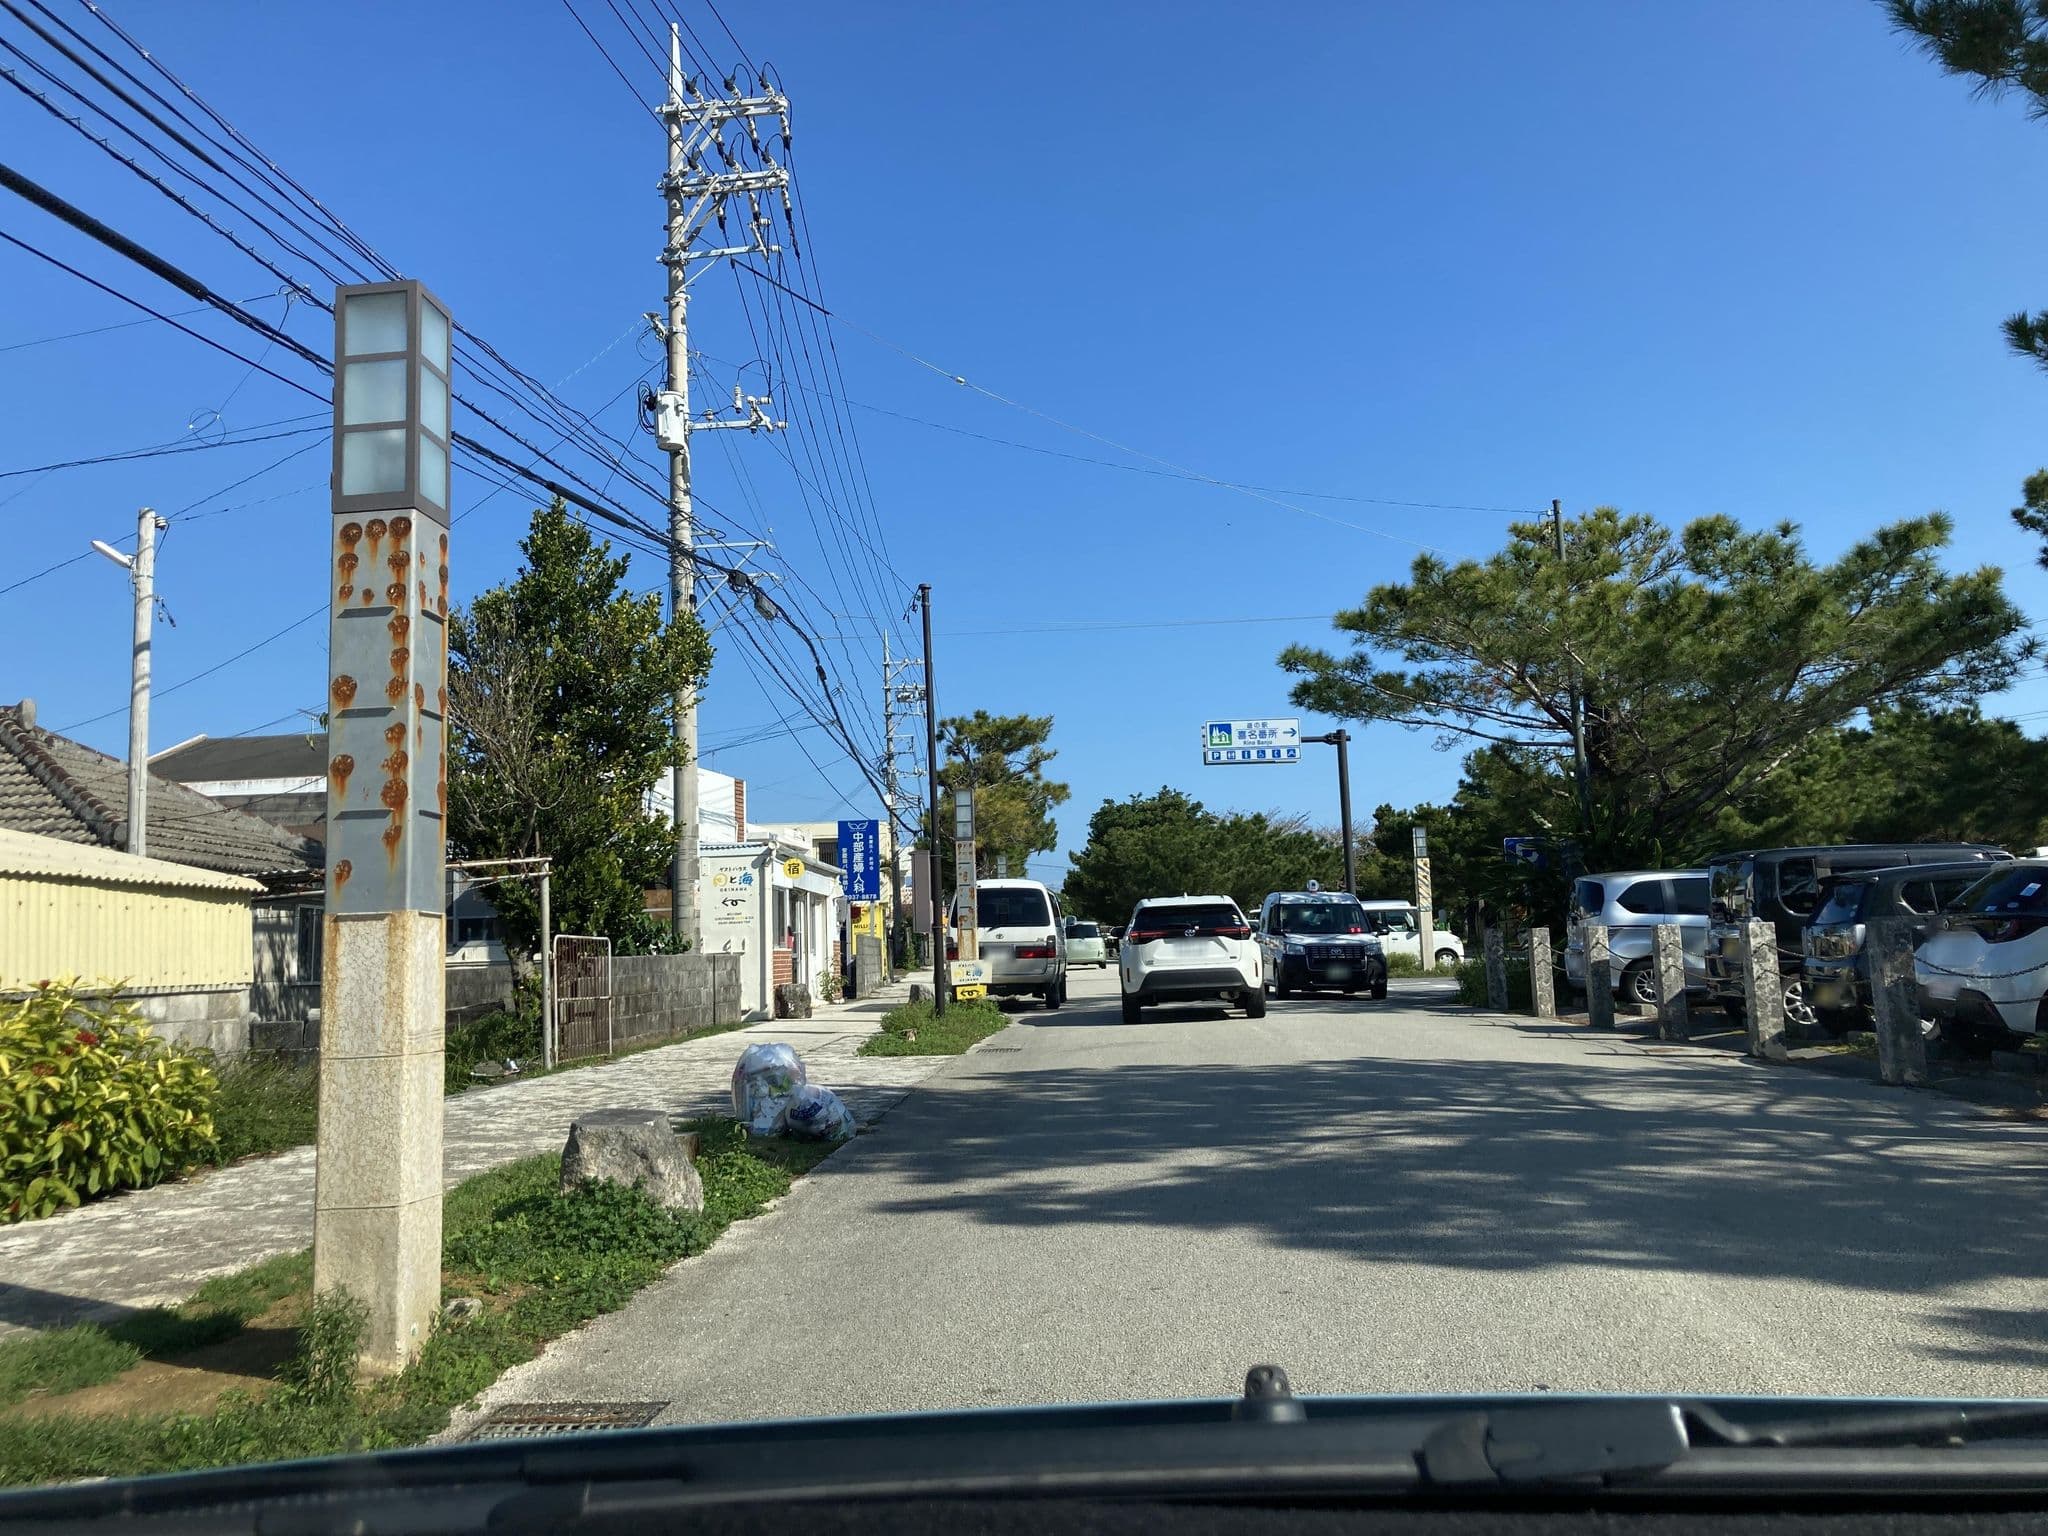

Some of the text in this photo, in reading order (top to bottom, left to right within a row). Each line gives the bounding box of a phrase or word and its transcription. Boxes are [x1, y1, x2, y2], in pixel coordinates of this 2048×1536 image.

[788, 862, 800, 875] 宿
[853, 831, 865, 894] 中部産婦人科
